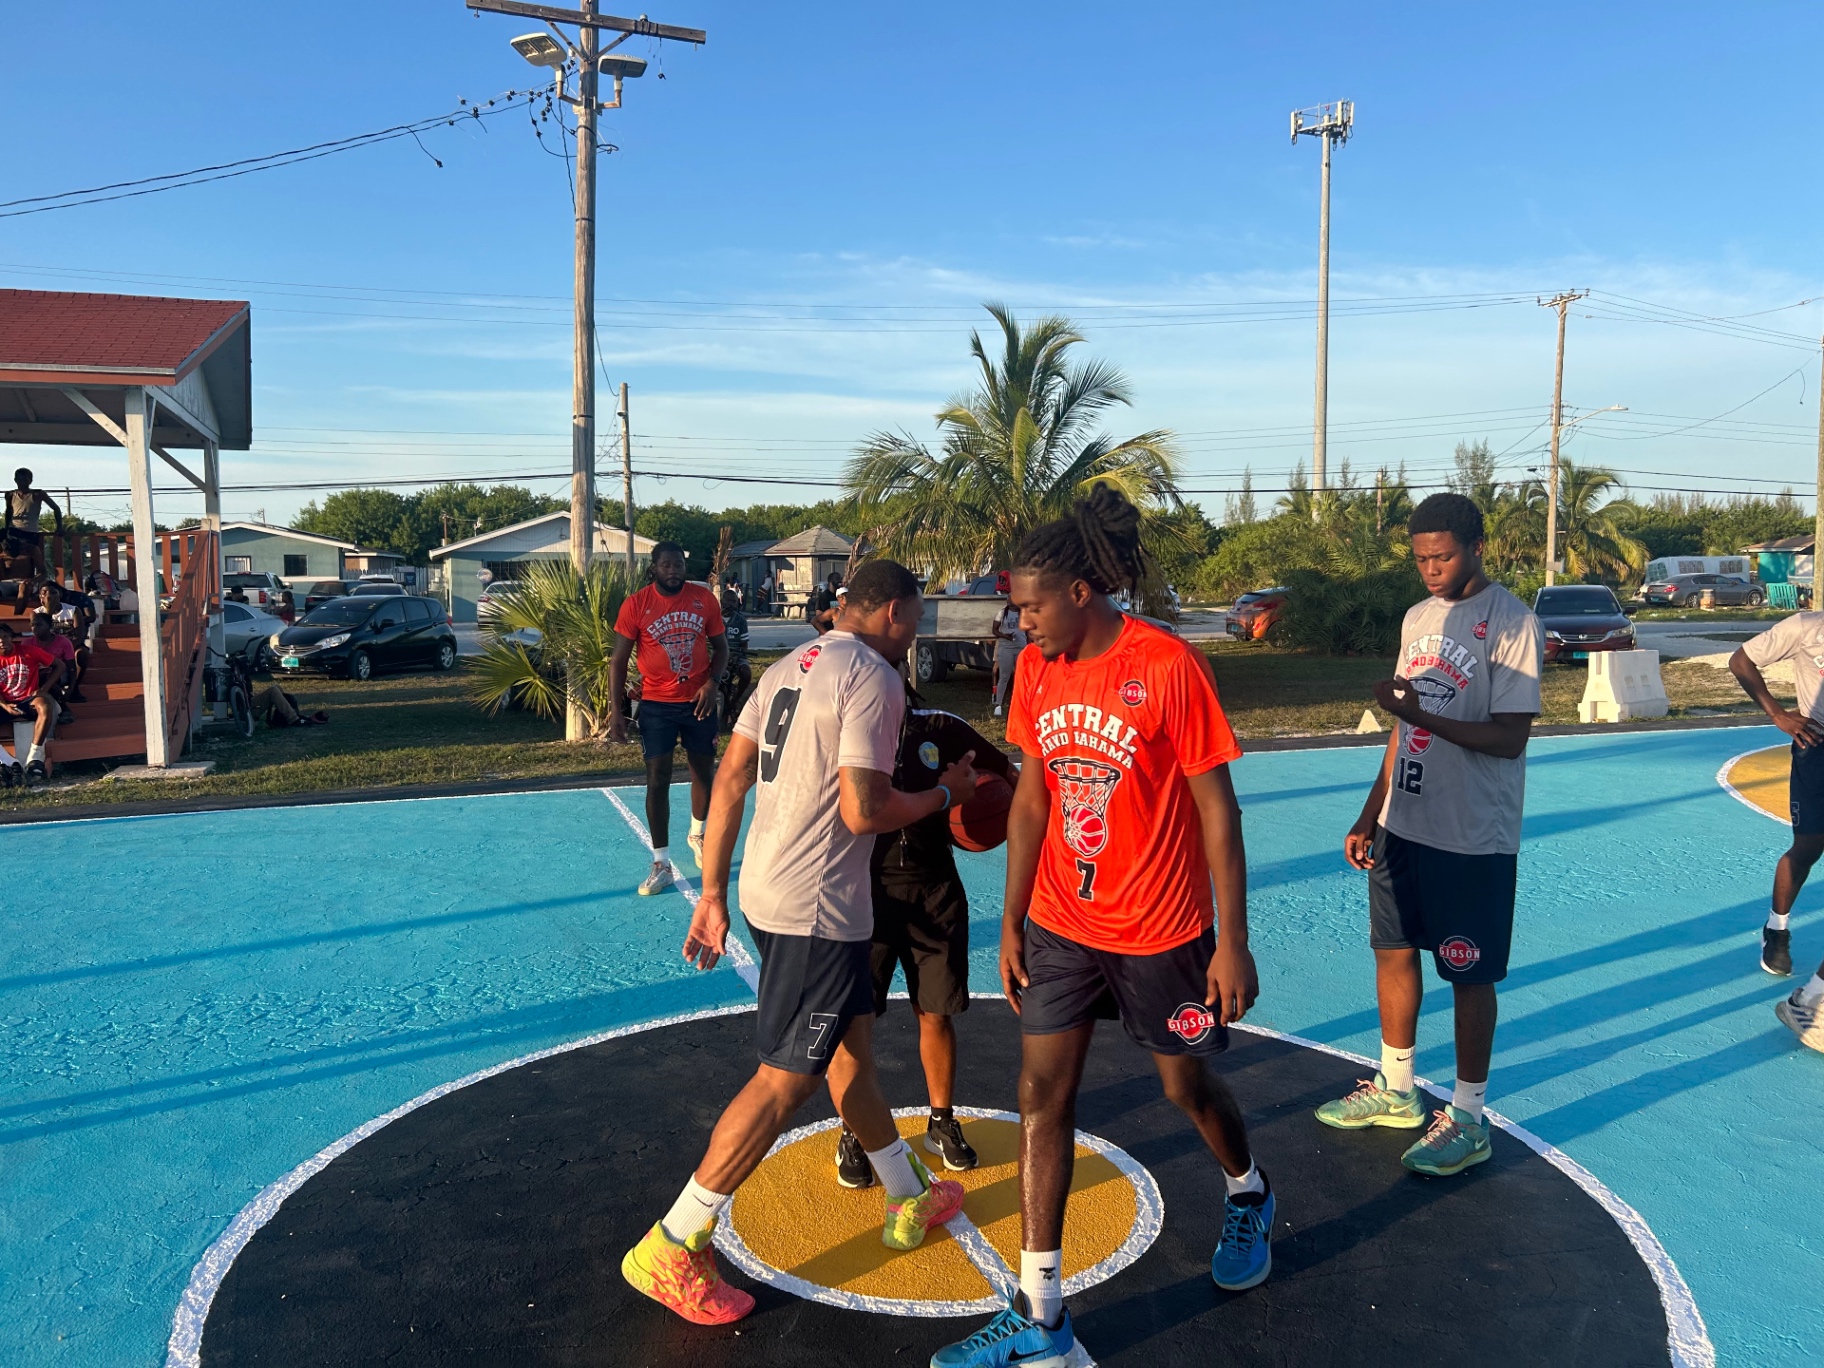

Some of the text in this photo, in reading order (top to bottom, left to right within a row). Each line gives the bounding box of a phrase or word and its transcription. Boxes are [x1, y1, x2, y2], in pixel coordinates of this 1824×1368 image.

[646, 611, 704, 635] CENTRAL
[652, 622, 673, 639] GRAND
[1406, 634, 1479, 679] ENTRAL
[760, 686, 803, 786] 9
[1035, 703, 1138, 754] ENTRAL
[1397, 756, 1424, 797] 12
[1075, 857, 1097, 902] 7
[1438, 946, 1480, 960] GIBSON
[807, 1012, 839, 1060] 7
[1167, 1013, 1215, 1031] GIBSON
